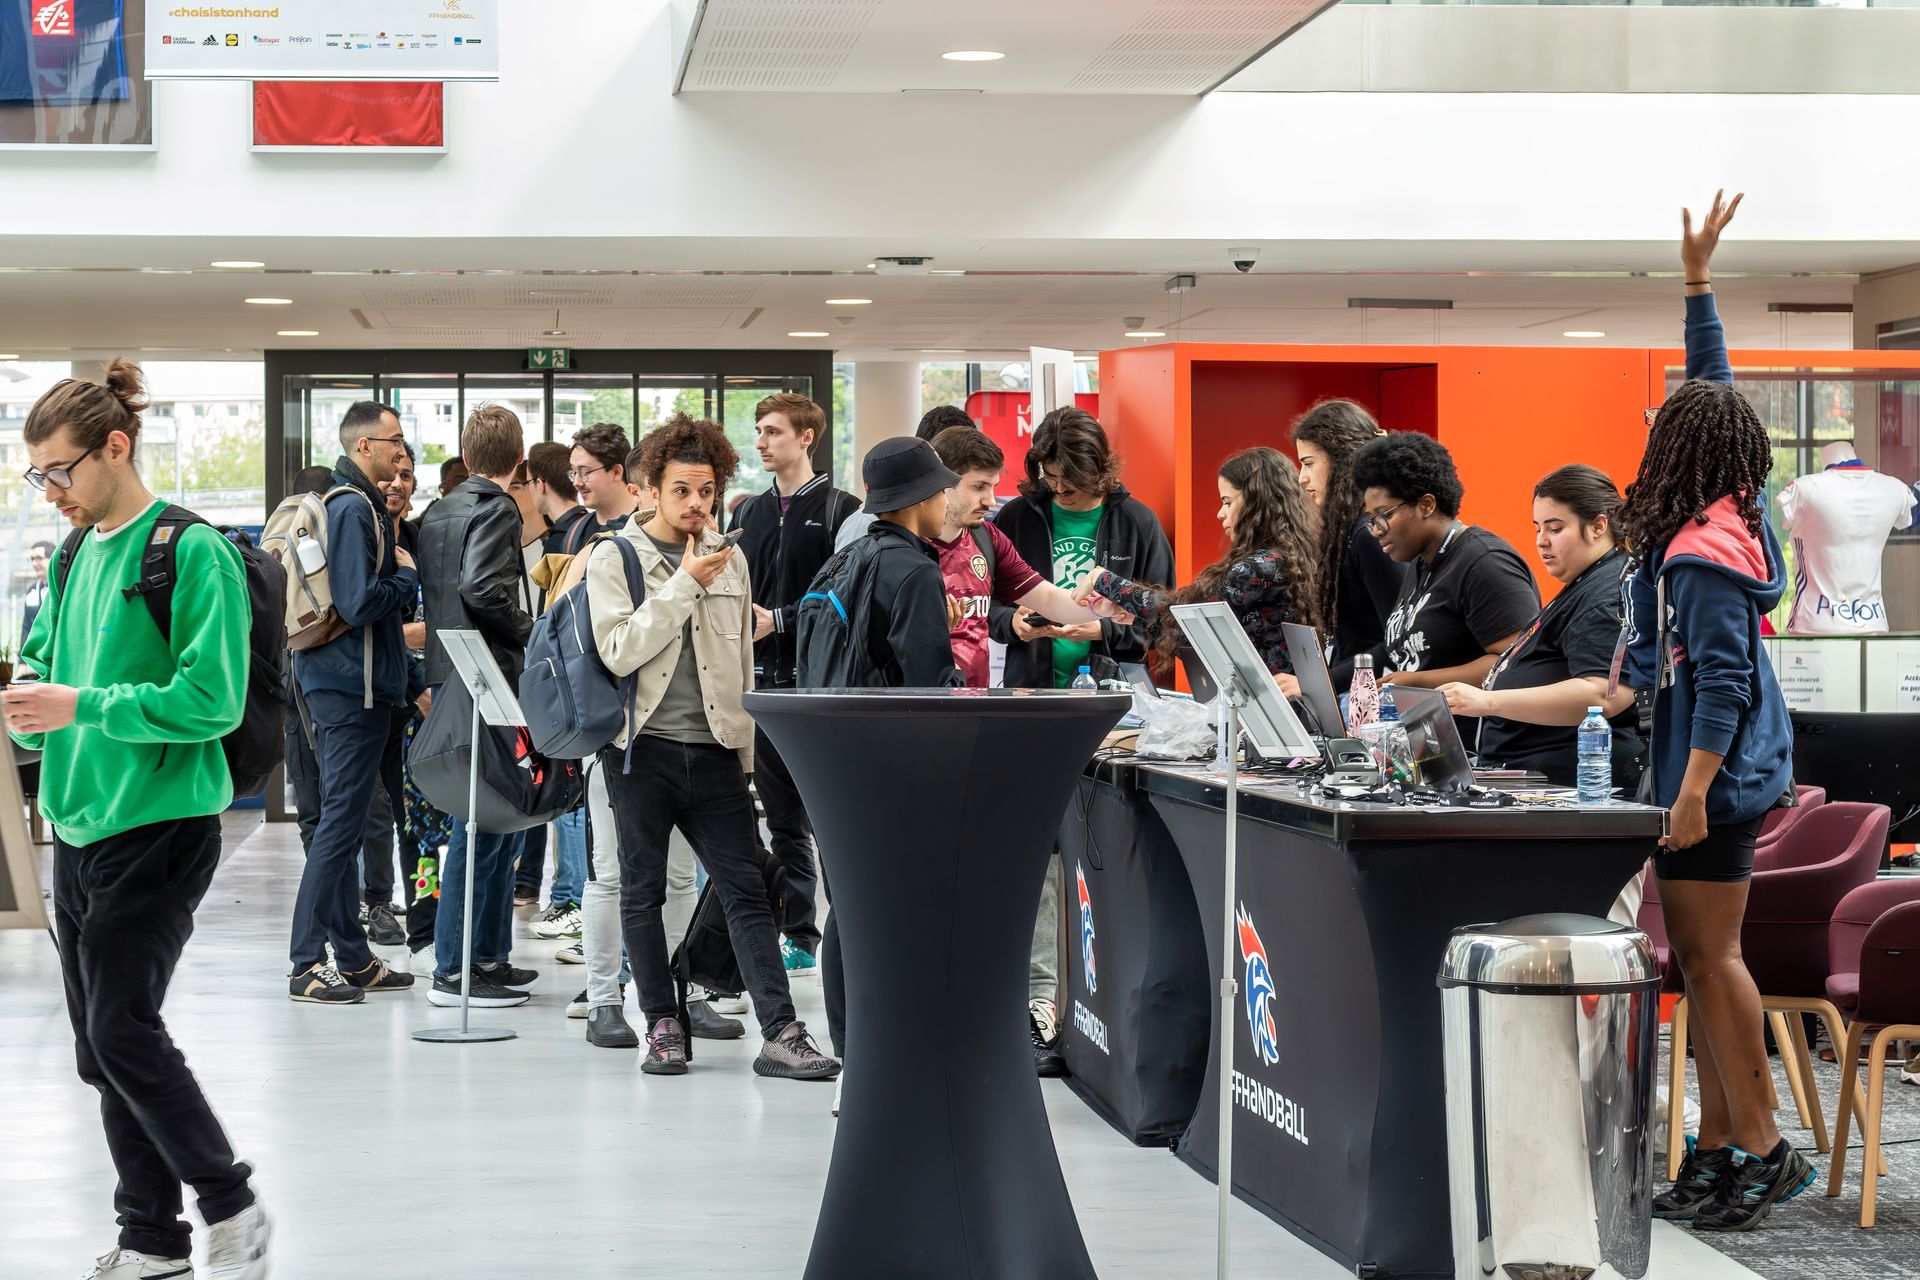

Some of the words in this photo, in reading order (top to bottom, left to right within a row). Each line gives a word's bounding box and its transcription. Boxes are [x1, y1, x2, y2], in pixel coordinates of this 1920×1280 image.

[168, 7, 280, 18] #choisistonhand
[288, 35, 312, 45] Préfon
[1816, 594, 1885, 623] Préfon
